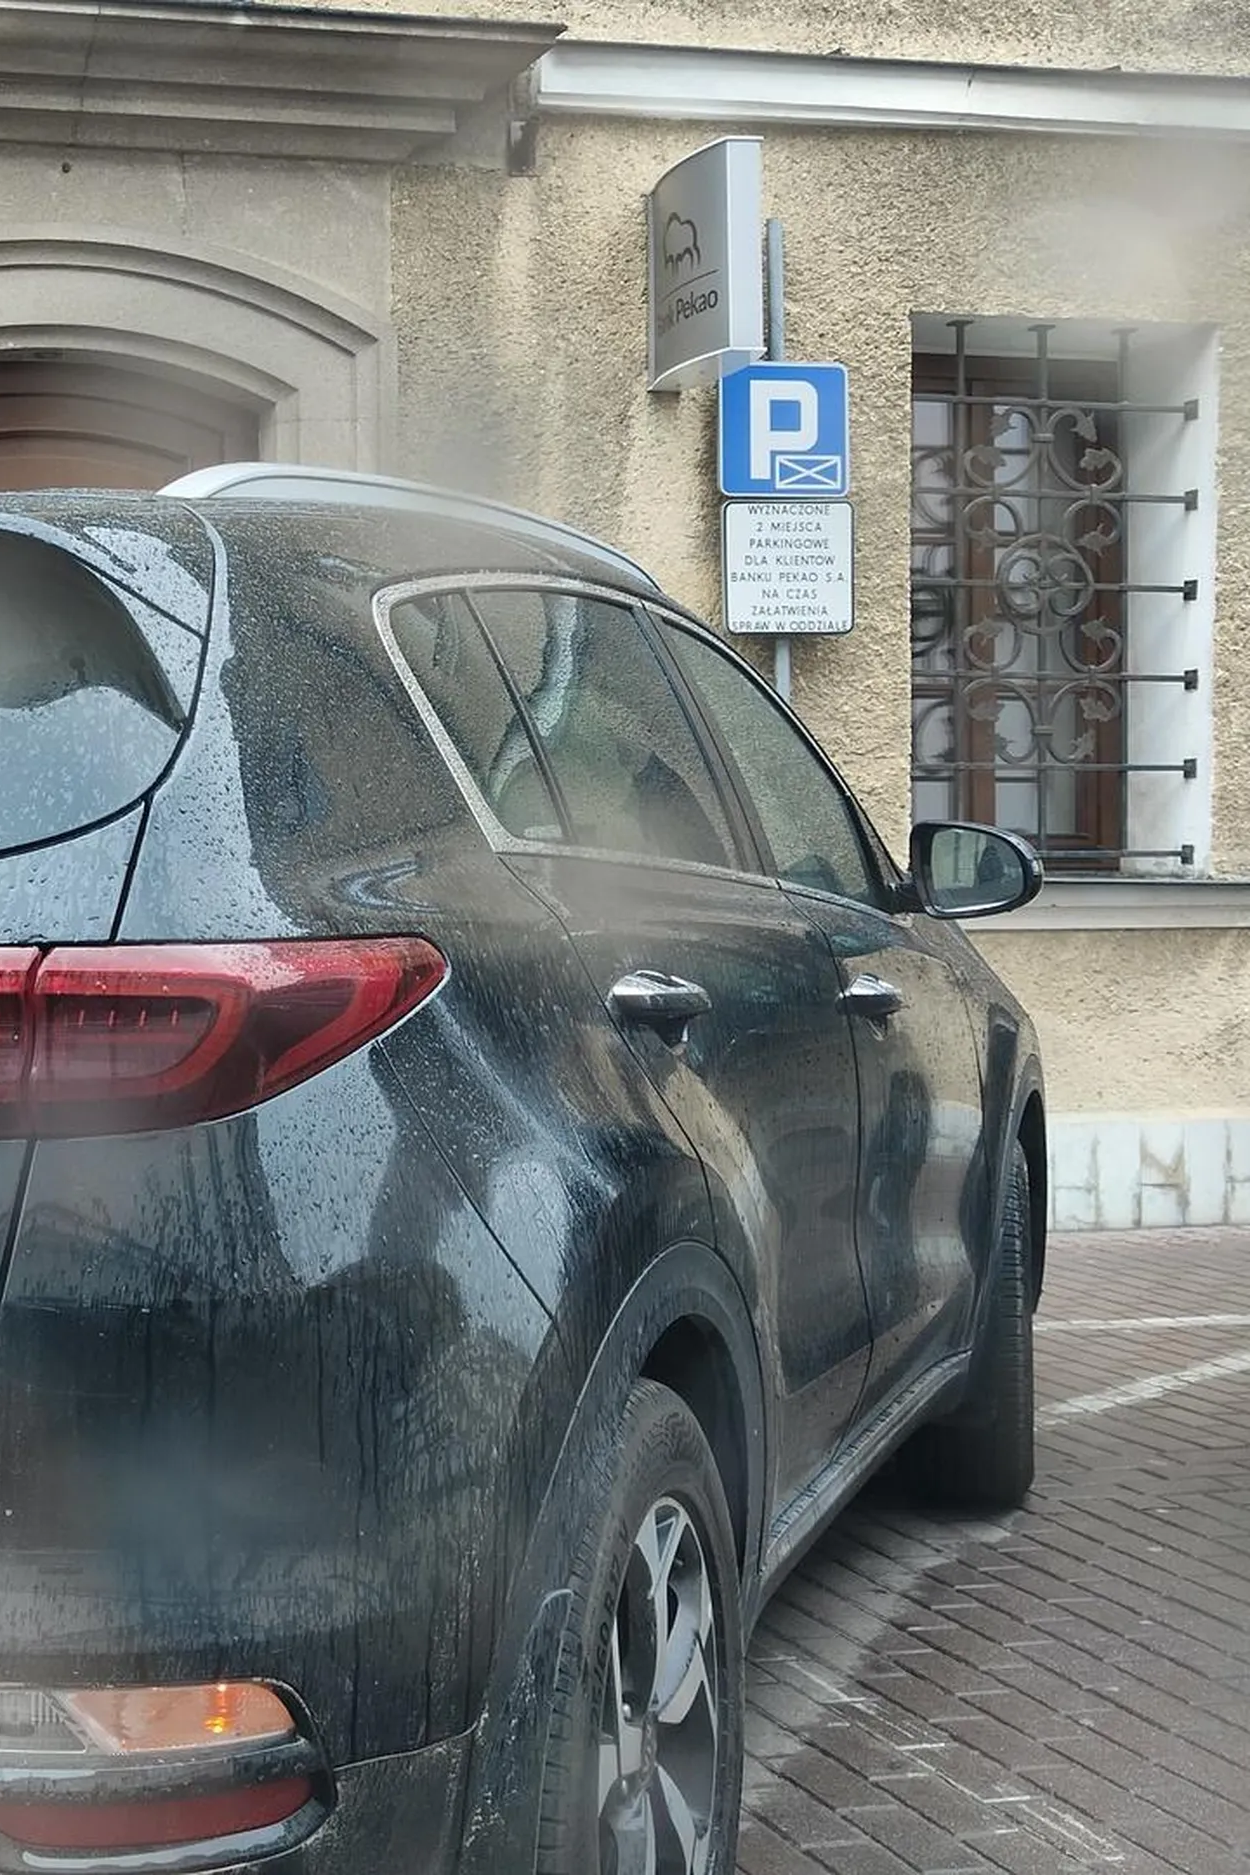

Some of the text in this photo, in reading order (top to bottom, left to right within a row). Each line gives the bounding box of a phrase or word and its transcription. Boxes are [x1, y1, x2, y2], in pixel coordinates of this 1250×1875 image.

[676, 290, 718, 323] Pekao
[750, 379, 818, 480] P
[748, 505, 831, 515] WYZNACZONE
[756, 522, 822, 532] 2 MIEJSCA
[749, 539, 830, 549] PARKINGOWE
[744, 555, 768, 566] DLA
[731, 572, 772, 582] BANKU
[779, 572, 818, 582] PEKAO
[761, 589, 818, 599] NA CZAS
[751, 605, 829, 616] ZAŁATWIENIA
[732, 621, 848, 631] SPRAW W ODDZIALE
